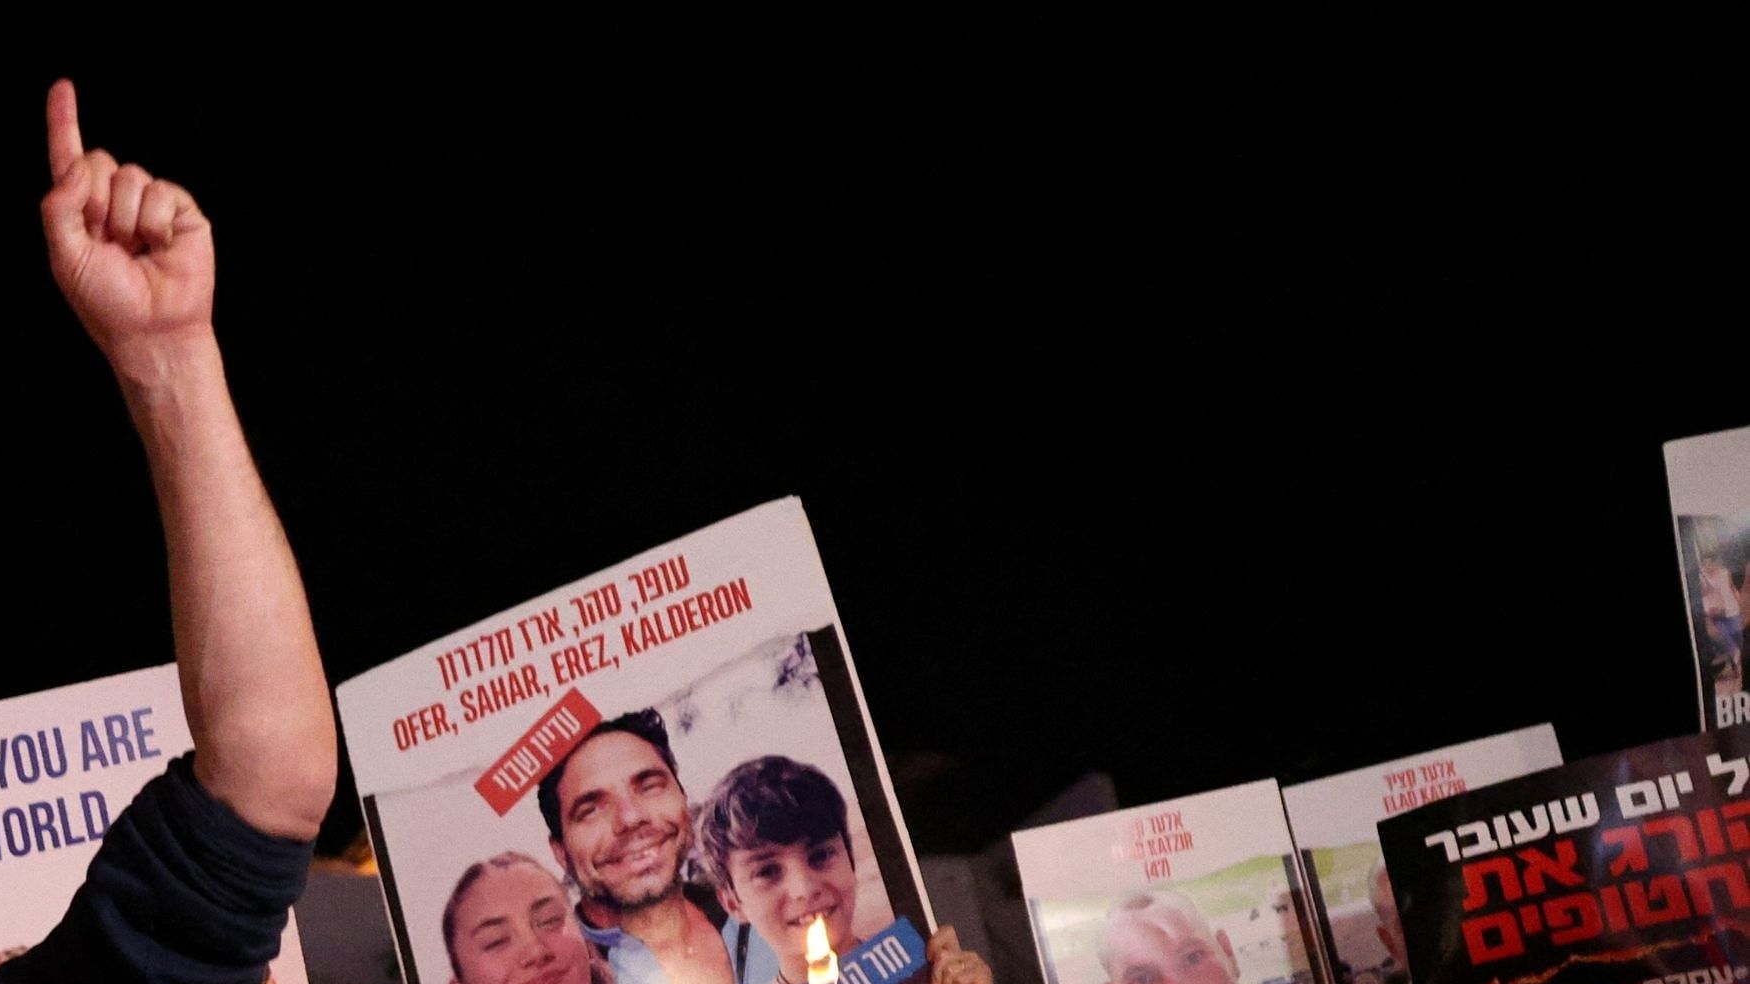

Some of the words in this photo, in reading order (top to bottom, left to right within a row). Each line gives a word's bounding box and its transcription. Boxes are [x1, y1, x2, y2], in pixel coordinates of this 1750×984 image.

[570, 583, 622, 638] סהר,
[628, 554, 691, 615] עופר,
[436, 628, 514, 691] קלדרון
[518, 607, 564, 651] ארז
[393, 702, 459, 753] OFER,
[460, 664, 551, 724] SAHAR,
[551, 634, 620, 687] EREZ,
[621, 577, 752, 657] KALDERON
[80, 707, 162, 772] ARE
[1615, 770, 1694, 820] יום
[1425, 792, 1601, 863] שעובר
[1462, 839, 1585, 913] את
[1461, 860, 1750, 966] חטופים
